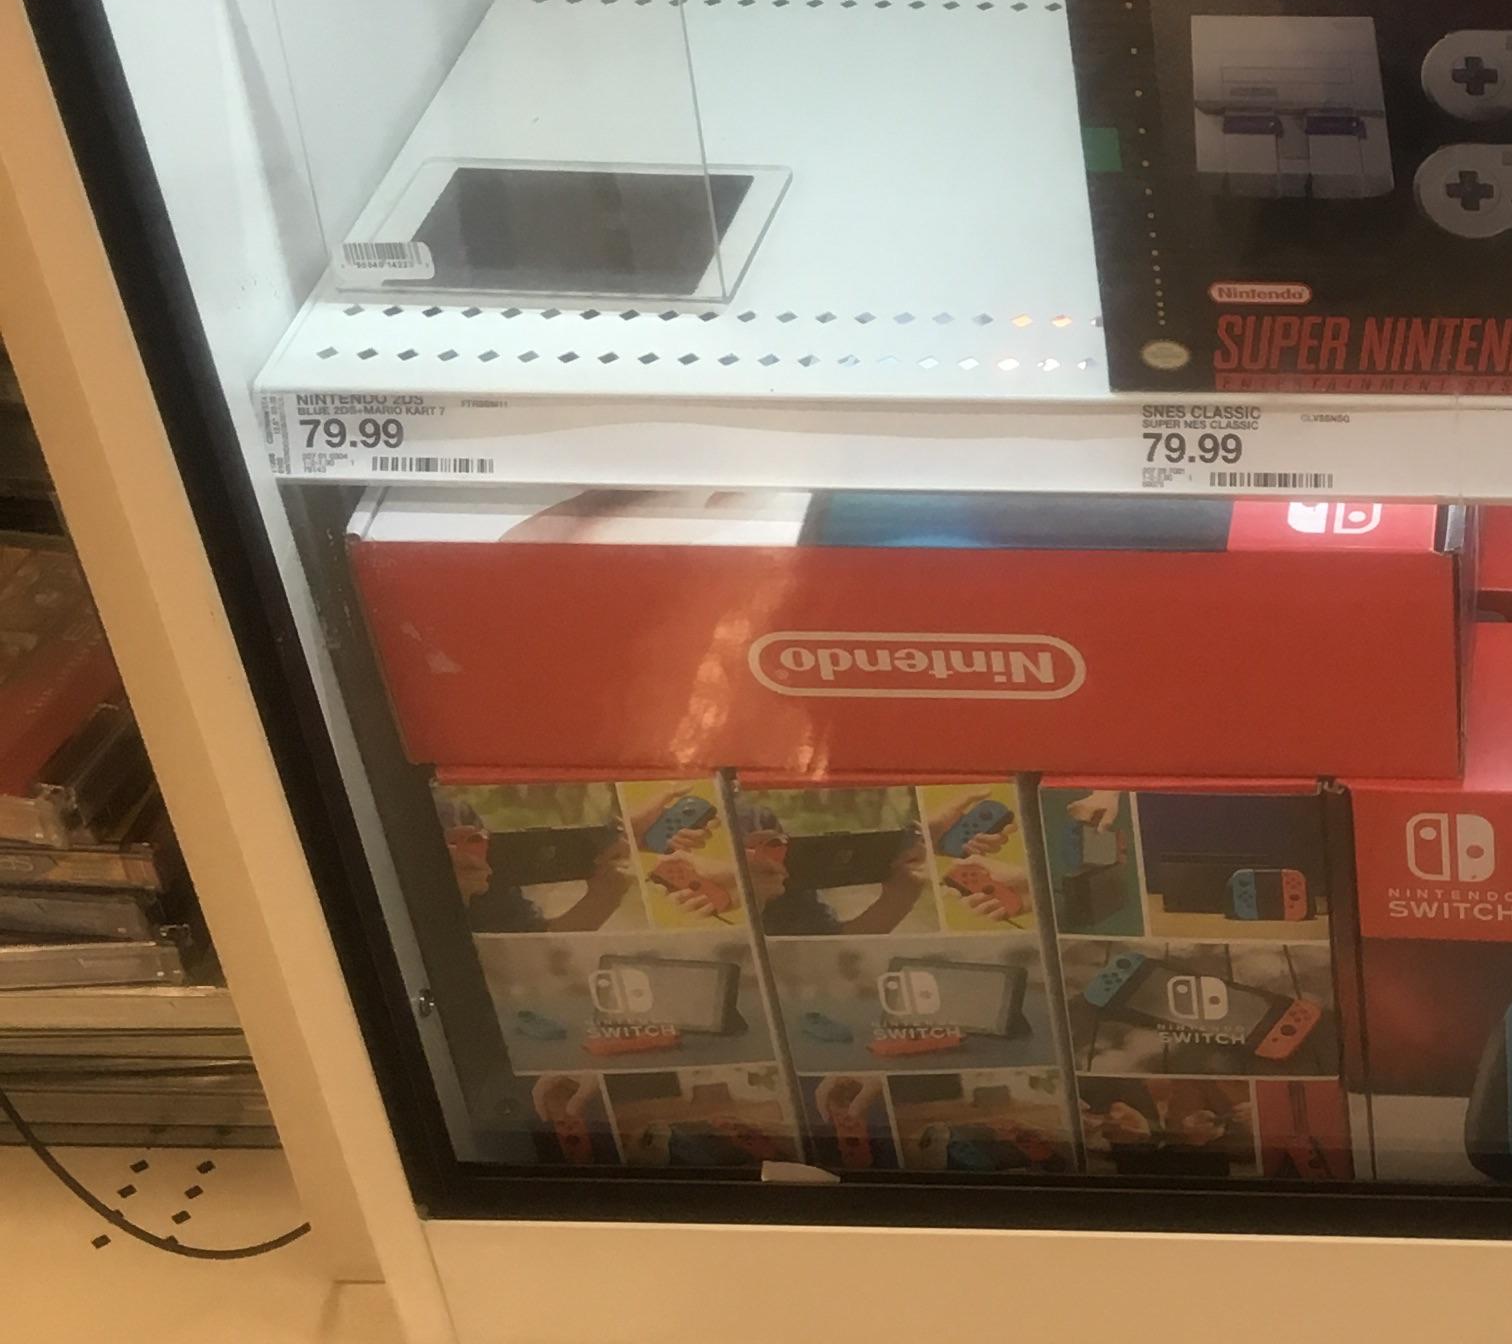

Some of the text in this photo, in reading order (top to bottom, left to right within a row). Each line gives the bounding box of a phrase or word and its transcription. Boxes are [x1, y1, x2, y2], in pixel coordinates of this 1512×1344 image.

[1218, 285, 1303, 301] Nintendo
[1214, 314, 1350, 370] SUPER
[296, 393, 424, 406] NINTENDO 2DS
[297, 406, 330, 416] BLUE
[405, 406, 436, 416] KART
[438, 407, 446, 416] 7
[1142, 405, 1262, 420] SNES CLASSIC
[1142, 419, 1259, 431] SUPER NES CLASSIC
[299, 417, 404, 449] 79.99
[1142, 432, 1243, 464] 79.99
[779, 646, 1056, 684] Nintendo
[586, 1024, 676, 1039] SWITCH
[872, 1025, 960, 1041] SWITCH
[1158, 1031, 1246, 1045] SWITCH
